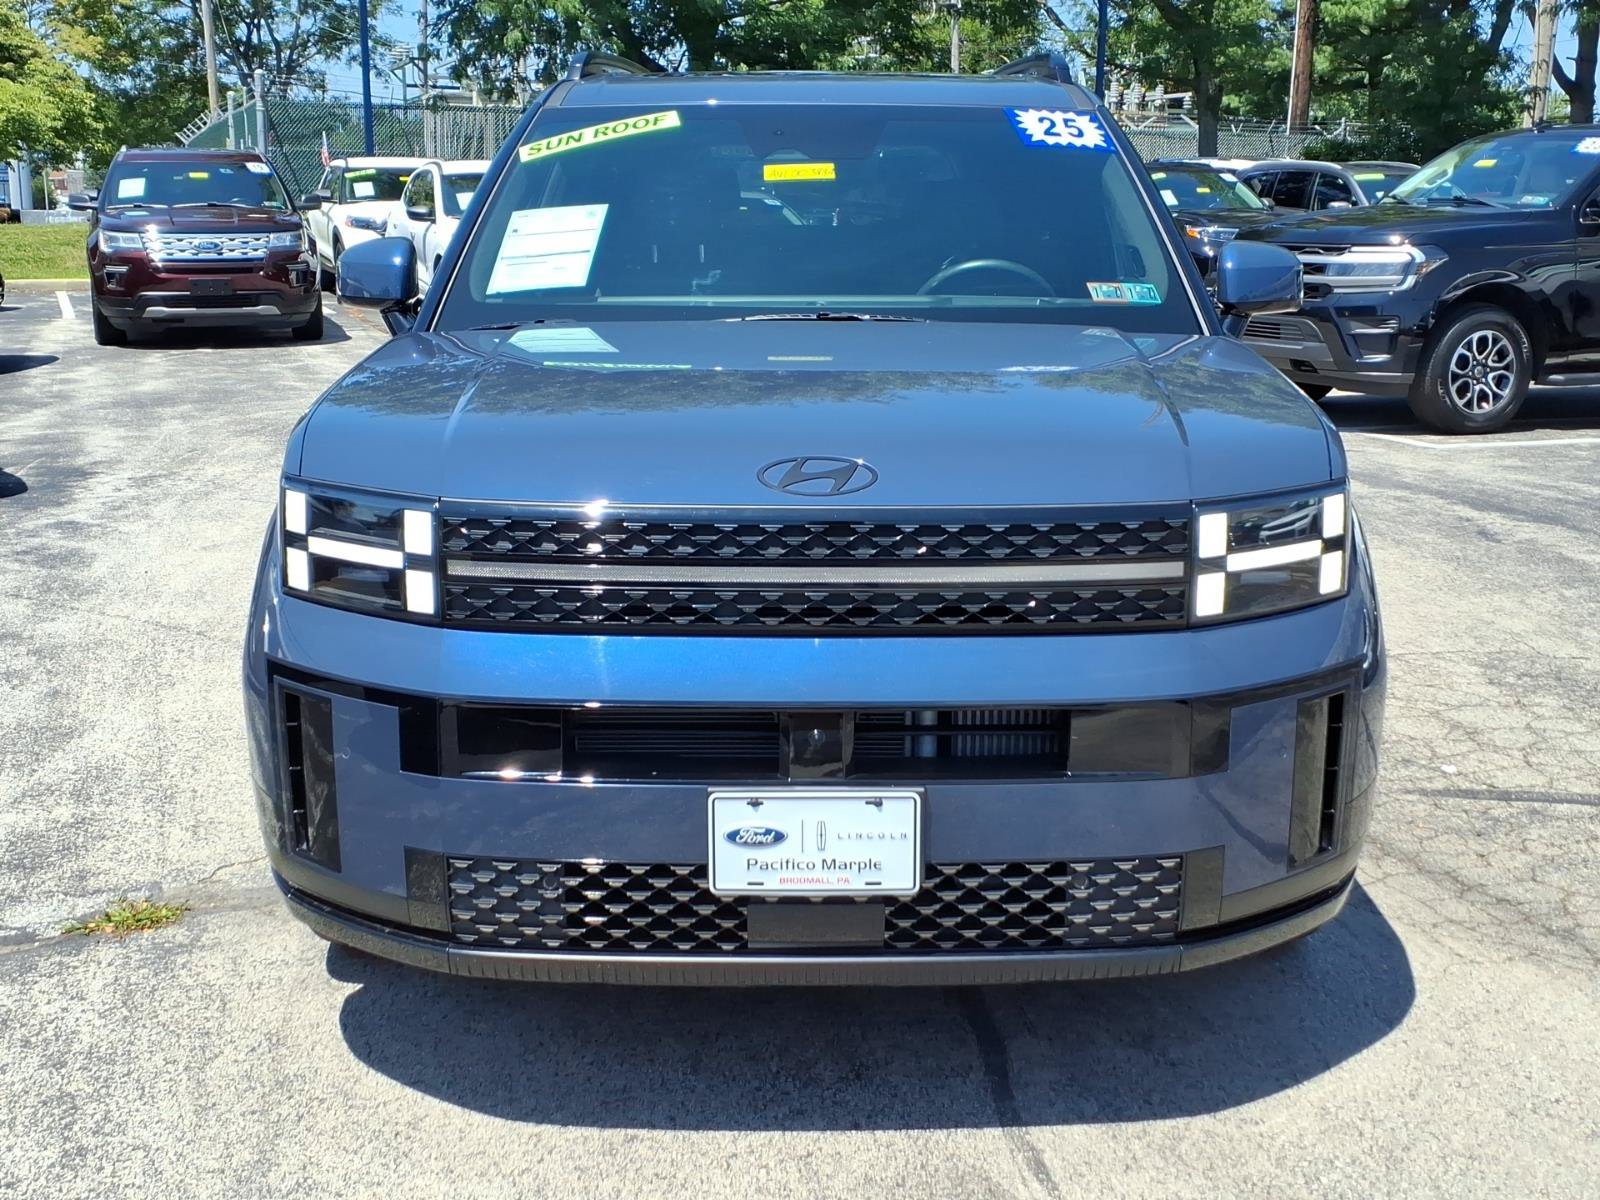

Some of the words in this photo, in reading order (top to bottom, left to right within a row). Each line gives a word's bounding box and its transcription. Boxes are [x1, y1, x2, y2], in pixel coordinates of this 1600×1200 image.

[527, 132, 583, 156] SUN
[592, 114, 668, 139] ROOF
[1037, 116, 1084, 138] 25
[735, 827, 775, 844] Ford
[837, 832, 908, 840] LINCOLN
[746, 858, 816, 871] Pacifico
[821, 858, 882, 874] Marple
[837, 876, 850, 885] PA
